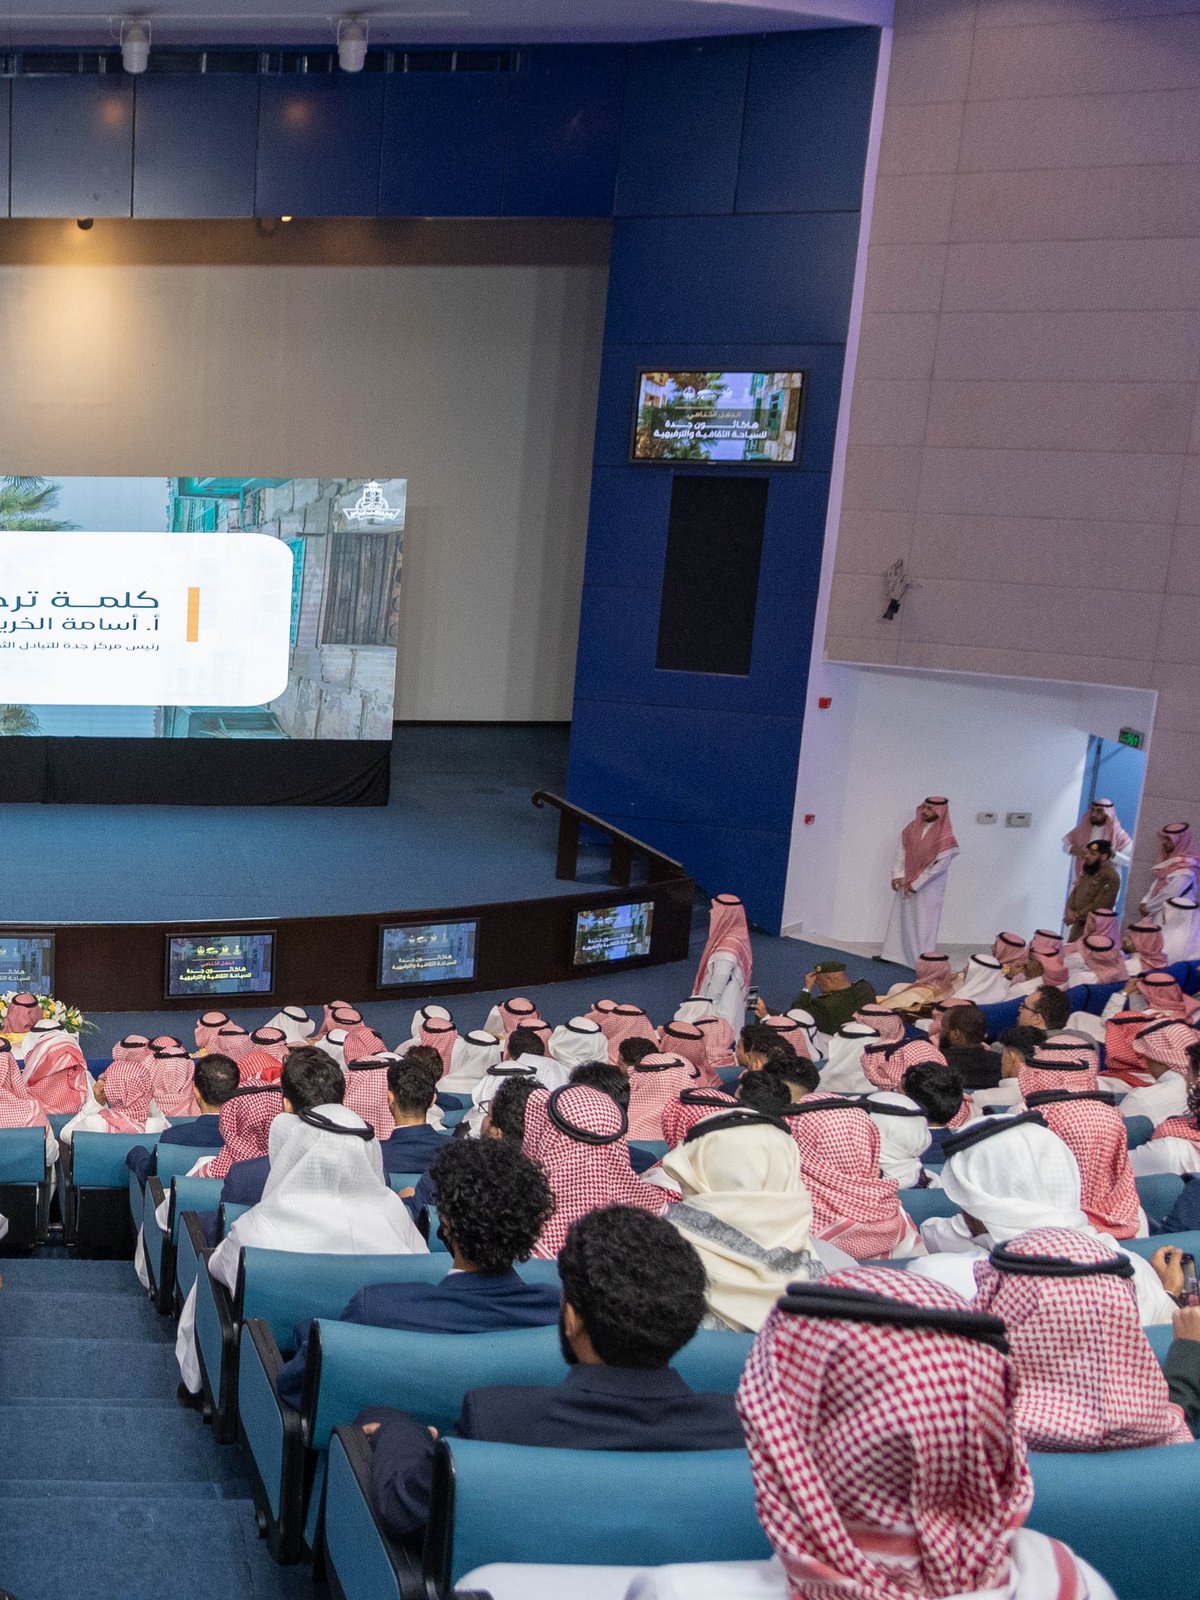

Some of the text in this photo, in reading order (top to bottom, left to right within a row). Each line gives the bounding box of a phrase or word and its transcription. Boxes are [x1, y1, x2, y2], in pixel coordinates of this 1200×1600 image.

[665, 420, 693, 429] جدة
[695, 430, 731, 440] الثقافية
[731, 430, 768, 440] للسياحة
[50, 590, 159, 609] كلمة
[61, 614, 139, 631] أسامة
[19, 641, 60, 650] للتبادل
[63, 641, 91, 650] جدة
[92, 641, 122, 652] مركز
[125, 641, 160, 652] رئيس
